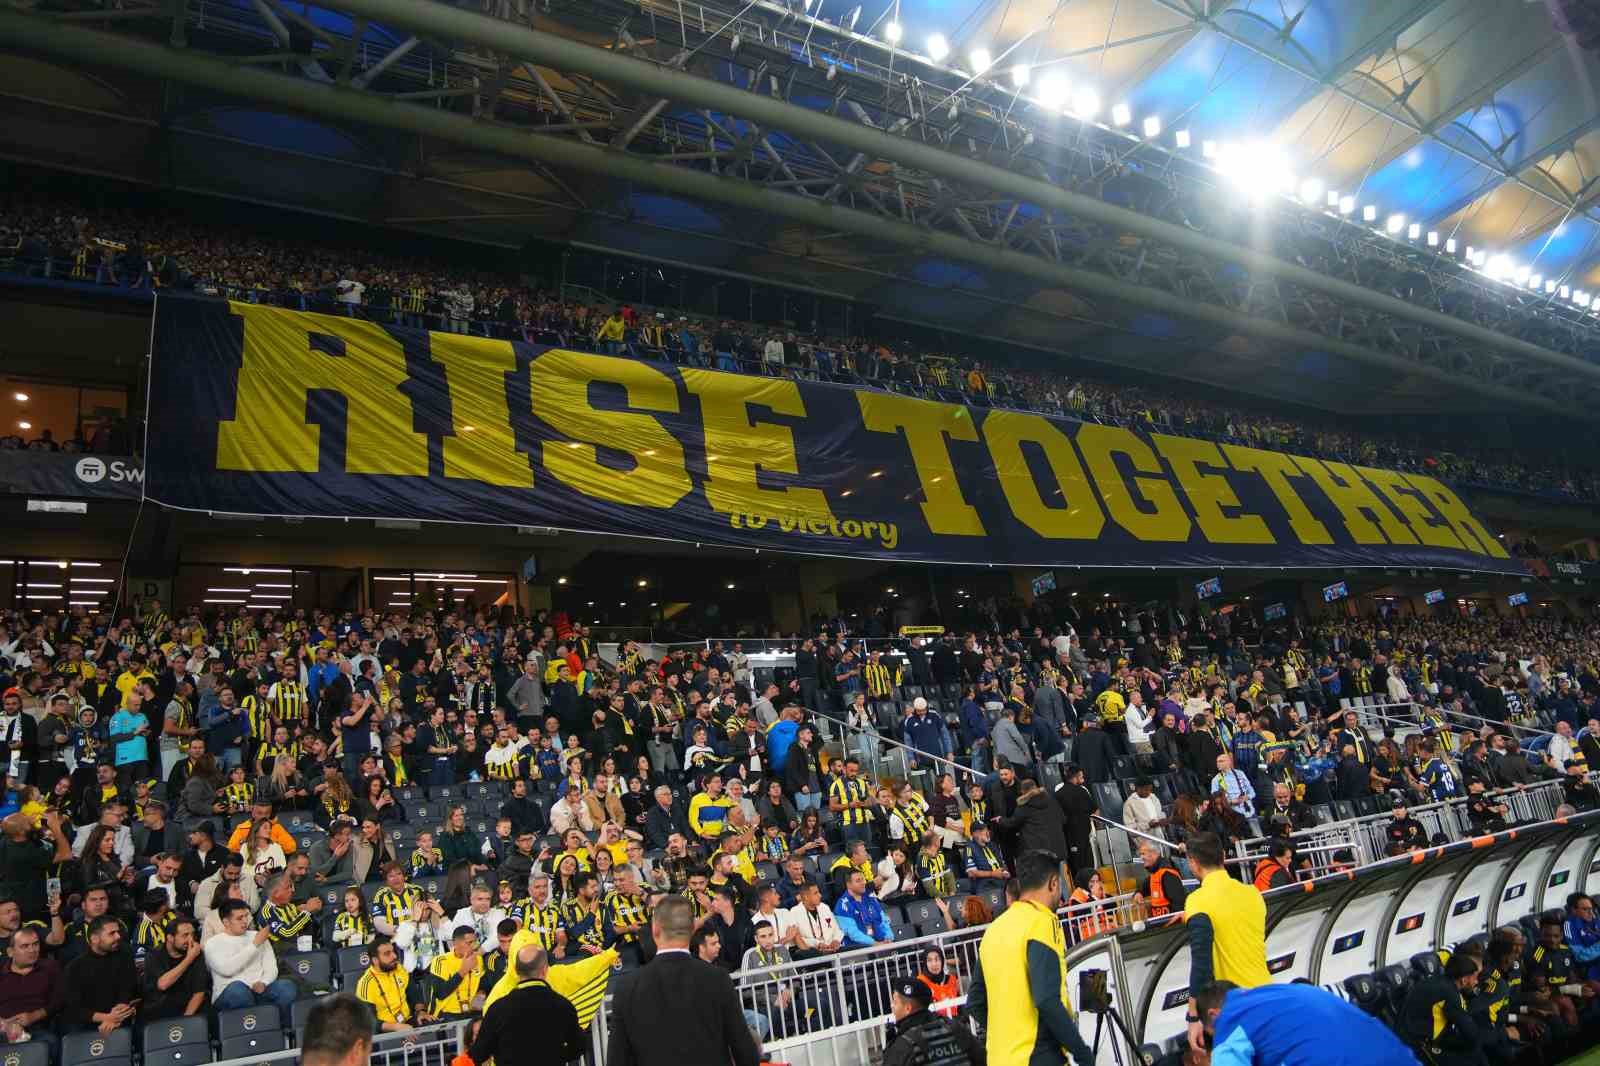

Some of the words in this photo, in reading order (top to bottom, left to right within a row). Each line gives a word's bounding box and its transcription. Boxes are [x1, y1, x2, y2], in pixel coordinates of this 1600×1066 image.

[215, 299, 833, 514] RISE
[855, 390, 1511, 559] TOGETHER
[778, 509, 898, 549] victory
